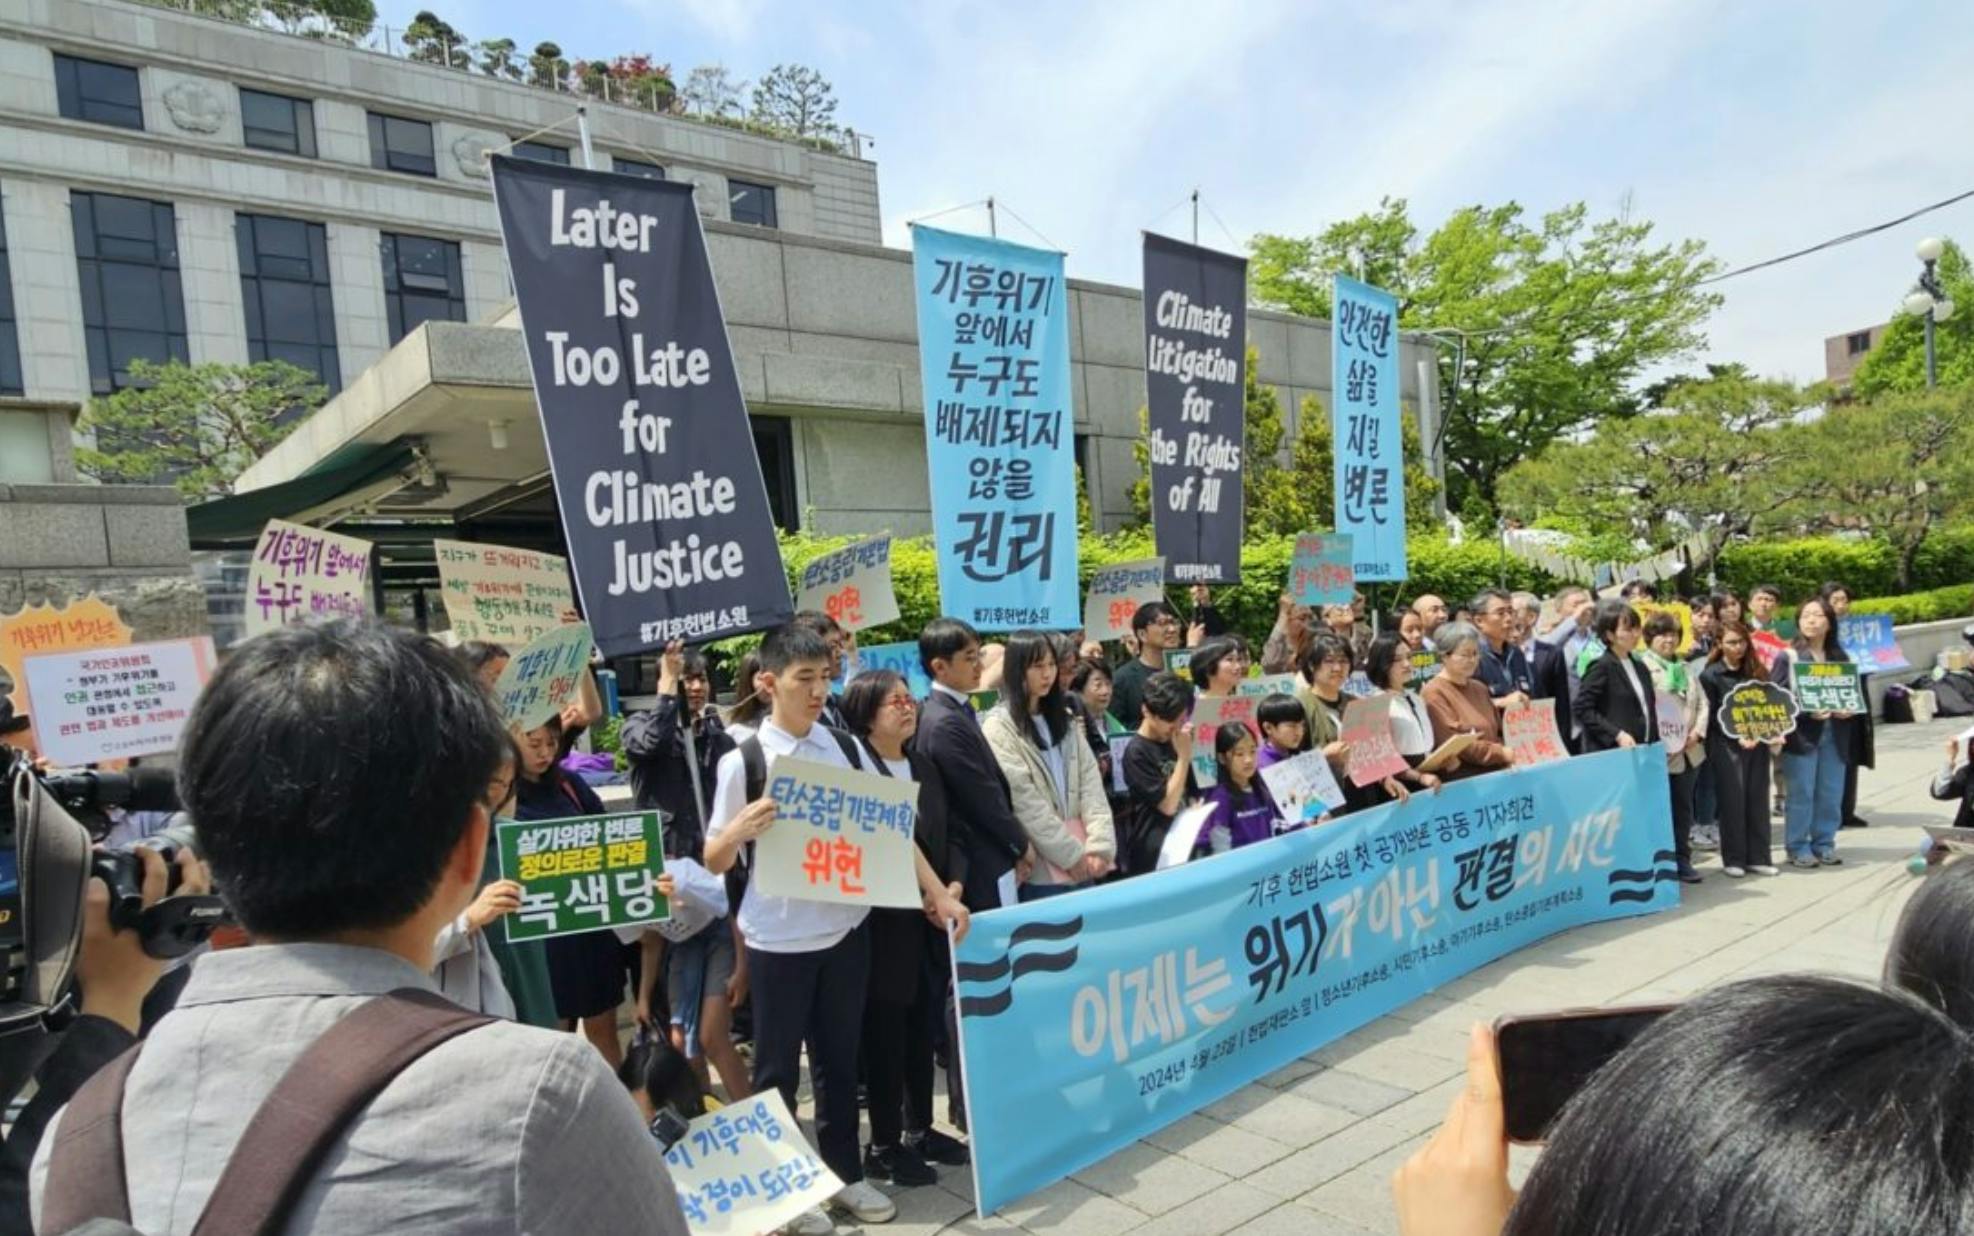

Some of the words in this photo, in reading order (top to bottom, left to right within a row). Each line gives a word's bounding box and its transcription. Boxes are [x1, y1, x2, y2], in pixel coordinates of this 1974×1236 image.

[551, 189, 658, 253] Later
[603, 263, 639, 318] Is
[931, 259, 1054, 316] 기후위기
[955, 312, 1033, 350] 앞에서
[1156, 290, 1232, 339] Climate
[1340, 299, 1392, 358] 안전한
[545, 332, 619, 386] Too
[632, 333, 711, 388] Late
[947, 352, 1039, 398] 누구도
[1149, 335, 1236, 384] Litigation
[1347, 359, 1377, 406] 삶을
[619, 400, 672, 454] for
[936, 399, 1062, 450] 배제되지
[1181, 386, 1213, 424] for
[1151, 428, 1176, 466] the
[1185, 431, 1240, 475] Rights
[585, 470, 736, 528] Climate
[969, 457, 1035, 500] 않을
[1169, 478, 1193, 512] of
[1197, 478, 1222, 513] All
[1344, 464, 1389, 524] 변론
[260, 528, 324, 578] 기후위기
[325, 544, 367, 581] 앞에서
[608, 535, 744, 596] Justice
[953, 511, 1055, 582] 권리
[641, 606, 751, 643] #기후헌법소원
[825, 585, 864, 624] 위헌
[973, 606, 1050, 625] #기후헌법소원
[1801, 688, 1858, 710] 녹색당
[770, 776, 913, 839] 탄소중립기본계획
[517, 821, 601, 855] 살기위한
[604, 817, 644, 843] 변론
[519, 847, 602, 880] 정의로운
[607, 840, 647, 868] 판결
[1248, 873, 1281, 907] 기후
[1287, 850, 1352, 896] 헌법소원
[1354, 841, 1375, 871] 첫
[1375, 821, 1432, 863] 공개변론
[1435, 811, 1470, 843] 공동
[1475, 795, 1534, 832] 기자회견
[802, 835, 865, 893] 위헌
[516, 869, 658, 930] 녹색당
[1069, 946, 1237, 1063] 이제는
[1244, 885, 1365, 1003] 위기가
[1368, 857, 1440, 943] 아닌
[1453, 824, 1553, 911] 판결의
[1556, 805, 1622, 875] 시간
[1138, 1058, 1186, 1096] 2024년
[1190, 1047, 1210, 1070] 4월
[1248, 1004, 1299, 1044] 헌법재판소
[692, 1101, 782, 1156] 기후대응
